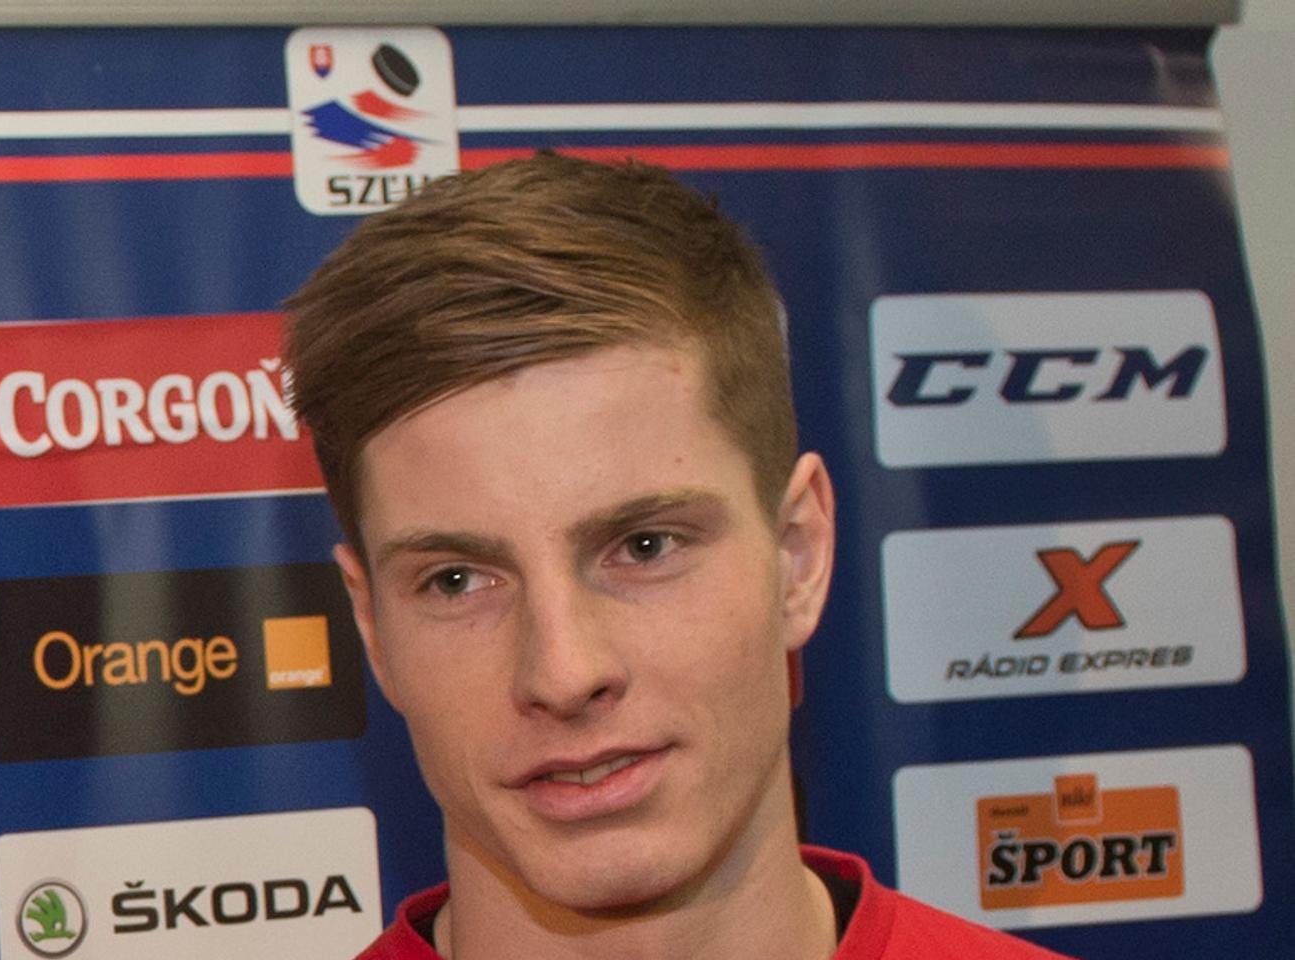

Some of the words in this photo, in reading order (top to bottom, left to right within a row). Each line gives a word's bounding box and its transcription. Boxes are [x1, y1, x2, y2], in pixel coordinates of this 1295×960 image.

[886, 343, 1209, 407] CCM
[33, 630, 238, 695] Orange
[946, 653, 1051, 681] RÁDIO
[1058, 645, 1194, 674] EXPRES
[988, 832, 1177, 886] ŠPORT
[111, 874, 363, 934] ŠKODA
